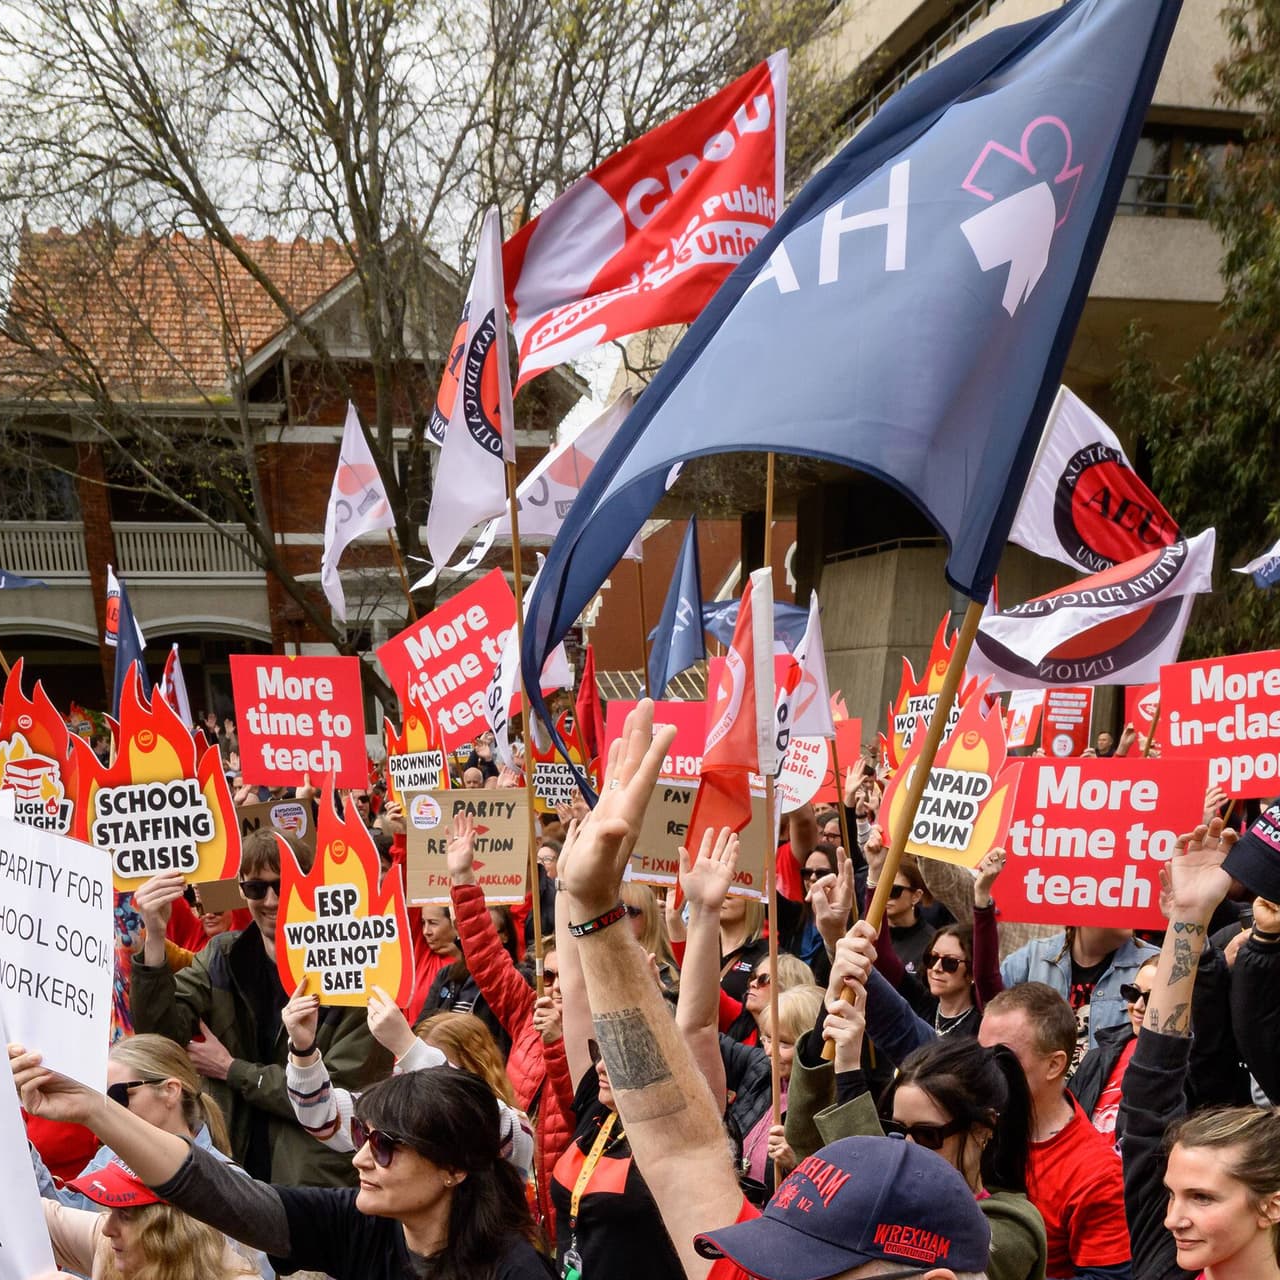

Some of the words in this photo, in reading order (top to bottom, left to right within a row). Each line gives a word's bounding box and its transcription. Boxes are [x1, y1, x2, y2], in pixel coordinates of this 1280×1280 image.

[703, 185, 776, 220] Public
[403, 604, 489, 670] More
[256, 667, 333, 701] More
[246, 703, 313, 737] time
[319, 709, 352, 738] to
[438, 687, 488, 735] tea
[261, 741, 342, 773] teach
[788, 736, 821, 755] roud
[390, 752, 442, 773] DROWNING
[395, 776, 406, 788] IN
[408, 772, 438, 787] ADMIN
[537, 786, 558, 797] ARE
[926, 772, 989, 797] NPAID
[1036, 766, 1159, 811] More
[99, 785, 202, 816] SCHOOL
[452, 799, 517, 819] PARITY
[663, 788, 691, 804] PAY
[920, 796, 975, 821] TAND
[96, 813, 211, 846] STAFFING
[913, 821, 969, 846] OWN
[1009, 814, 1116, 860] time
[1126, 822, 1178, 861] to
[116, 844, 195, 874] CRISIS
[67, 871, 104, 910] FOR
[1023, 865, 1152, 909] teach
[318, 888, 358, 917] ESP
[287, 917, 396, 946] WORKLOADS
[306, 949, 337, 968] ARE
[341, 945, 379, 966] NOT
[324, 970, 363, 991] SAFE
[796, 1196, 815, 1213] NZ
[873, 1223, 952, 1260] WREXHAM
